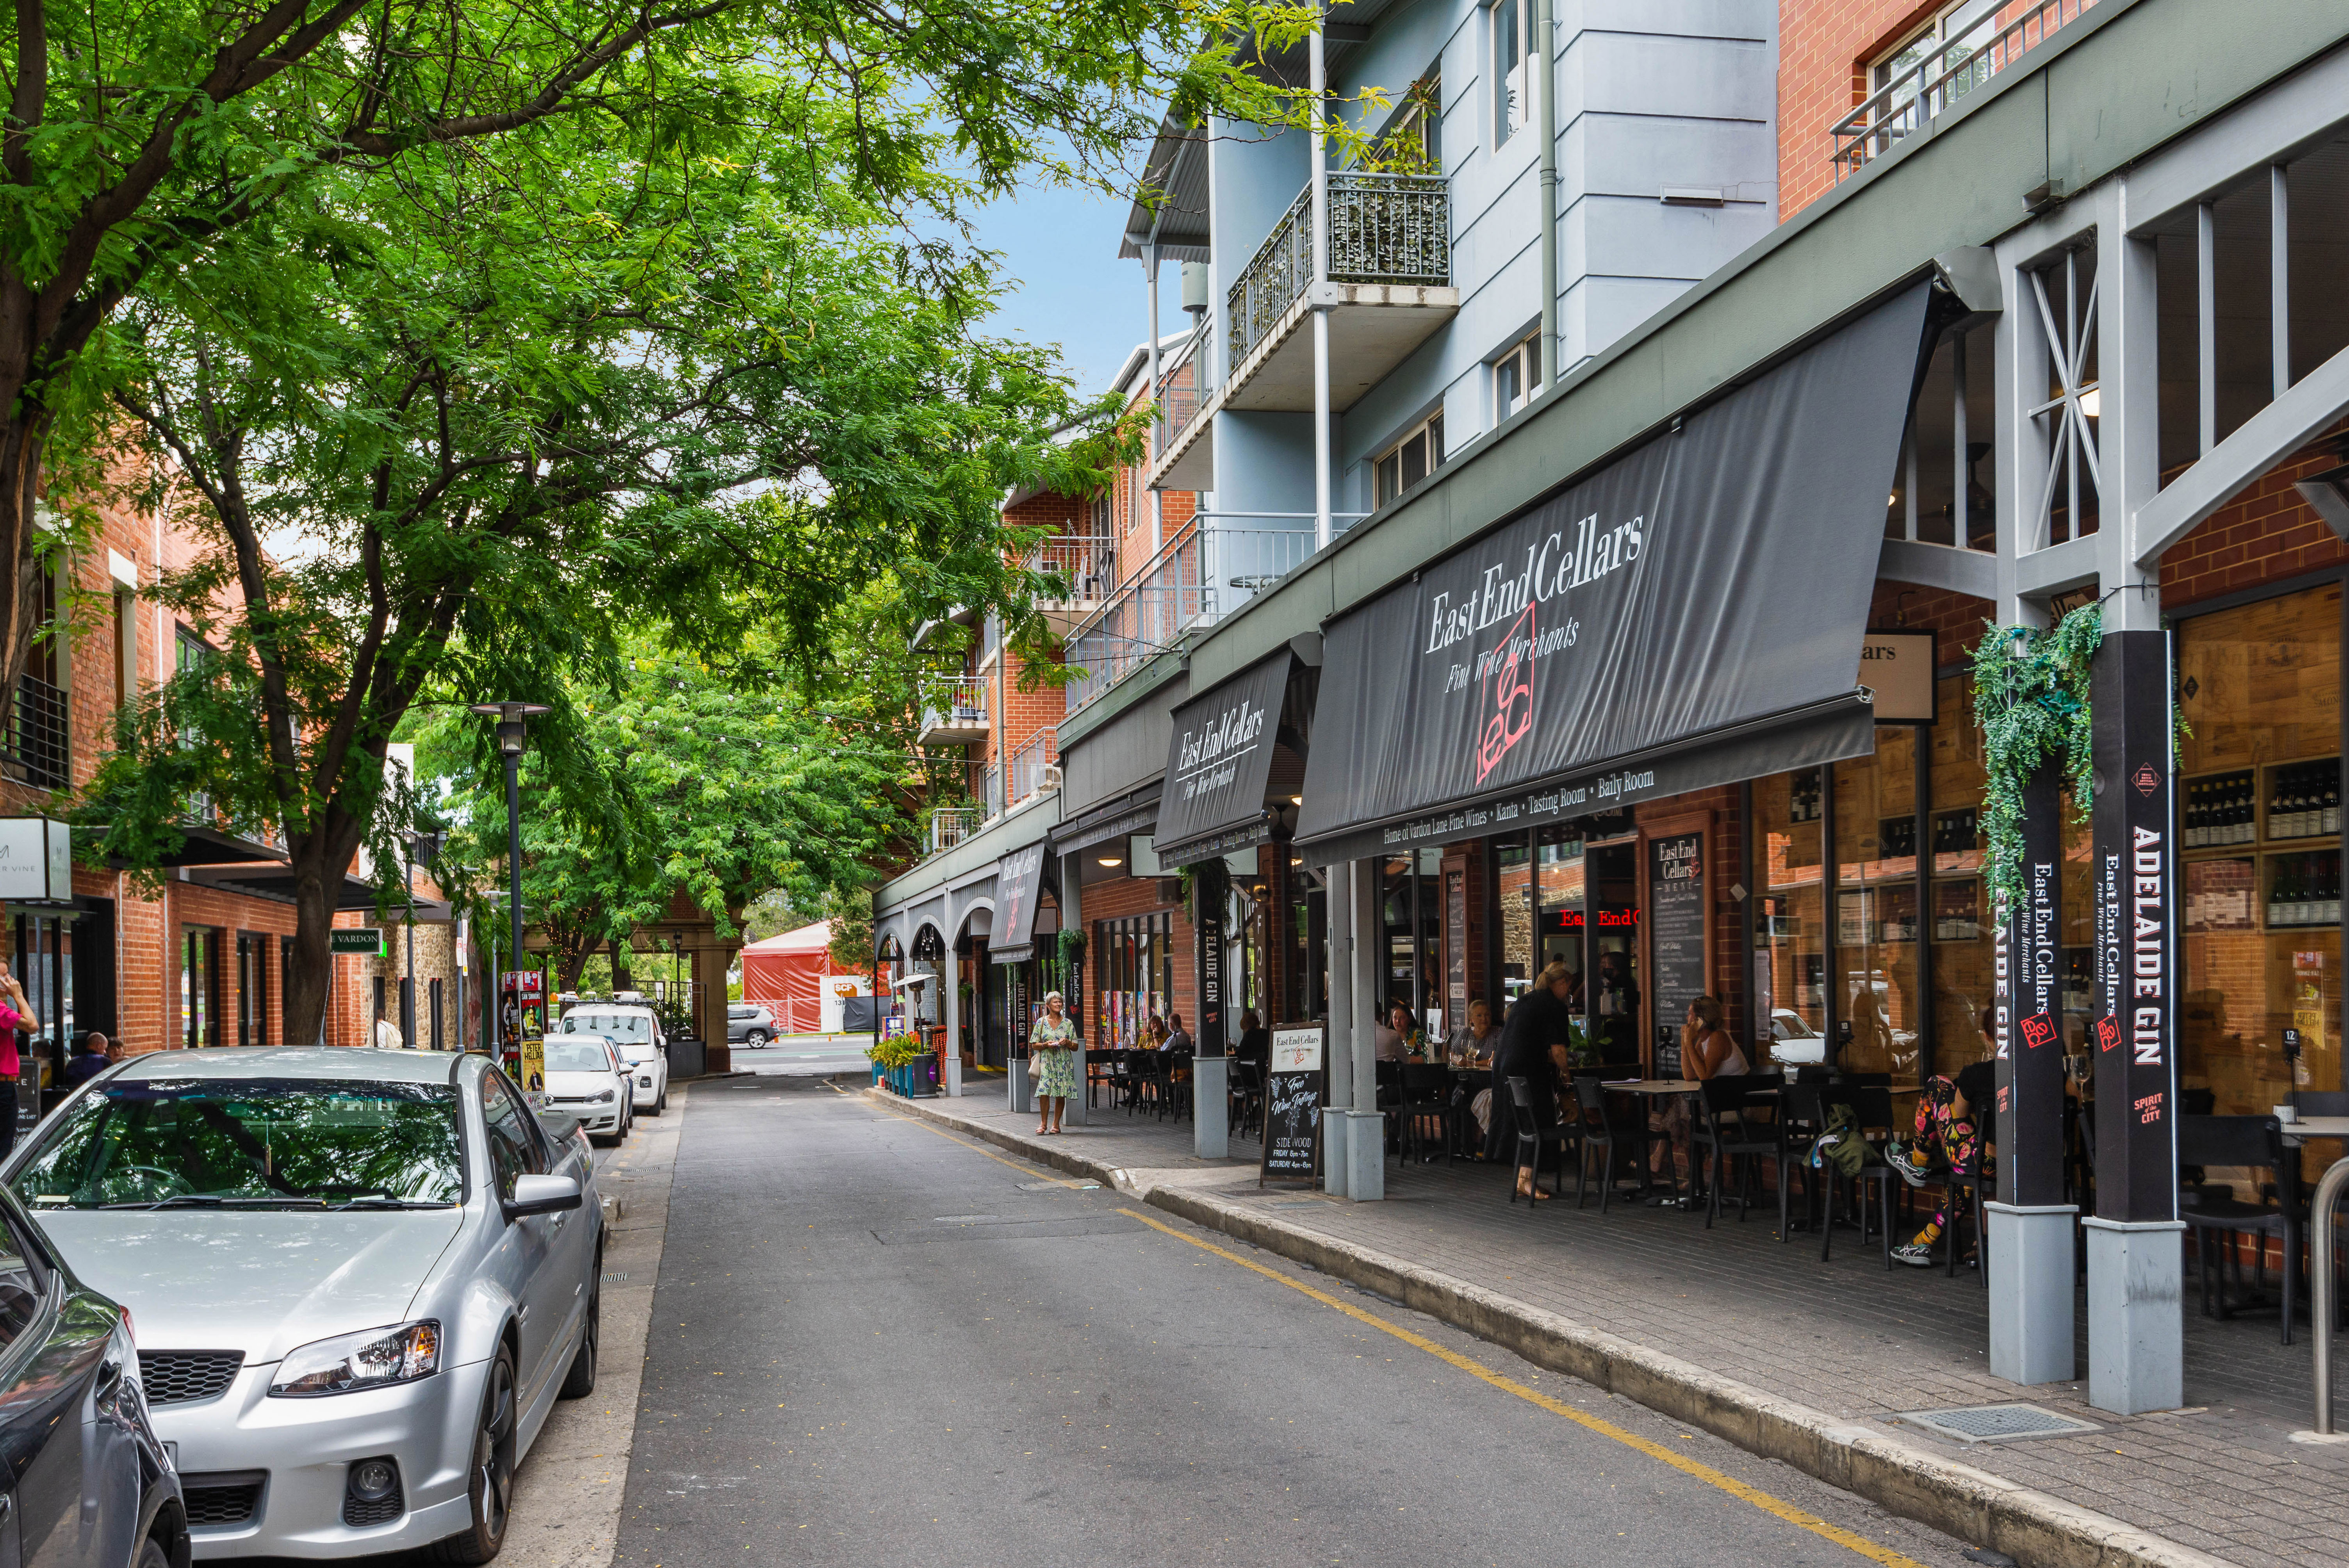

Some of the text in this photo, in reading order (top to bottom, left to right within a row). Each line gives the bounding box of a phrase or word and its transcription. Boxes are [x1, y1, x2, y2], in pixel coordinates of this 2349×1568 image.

[1426, 513, 1643, 654] East End Cellars
[1445, 617, 1579, 693] Fine Wine Merchants
[1178, 700, 1264, 772] East End Cellars
[1183, 780, 1196, 800] Fine
[1384, 770, 1654, 844] Home of Vardon Lane Fine Wines Kanta Tasting Room Baily Room
[1258, 825, 1269, 837] Room
[1658, 839, 1697, 861] East End
[1003, 857, 1014, 881] East
[1662, 860, 1693, 879] Cellars
[2022, 912, 2031, 934] Wine
[2035, 862, 2054, 1015] East End Cellars
[2107, 853, 2120, 1016] East End Cellars
[2134, 826, 2162, 1065] ADELAIDE GIN
[2022, 936, 2032, 983] Merchants
[1017, 982, 1025, 1021] ADELAIDE
[1207, 982, 1217, 1002] GIN
[1277, 1035, 1319, 1046] East End Cellars
[1996, 1006, 2008, 1060] GIN
[2286, 1030, 2295, 1040] 12
[524, 1051, 543, 1060] HELLIAR
[526, 1044, 541, 1052] PETER
[1288, 1076, 1305, 1094] Free
[1997, 1086, 2008, 1099] SPIRIT
[1272, 1092, 1318, 1115] Wine Tastings
[2134, 1092, 2163, 1110] SPIRIT
[2142, 1110, 2161, 1124] CITY
